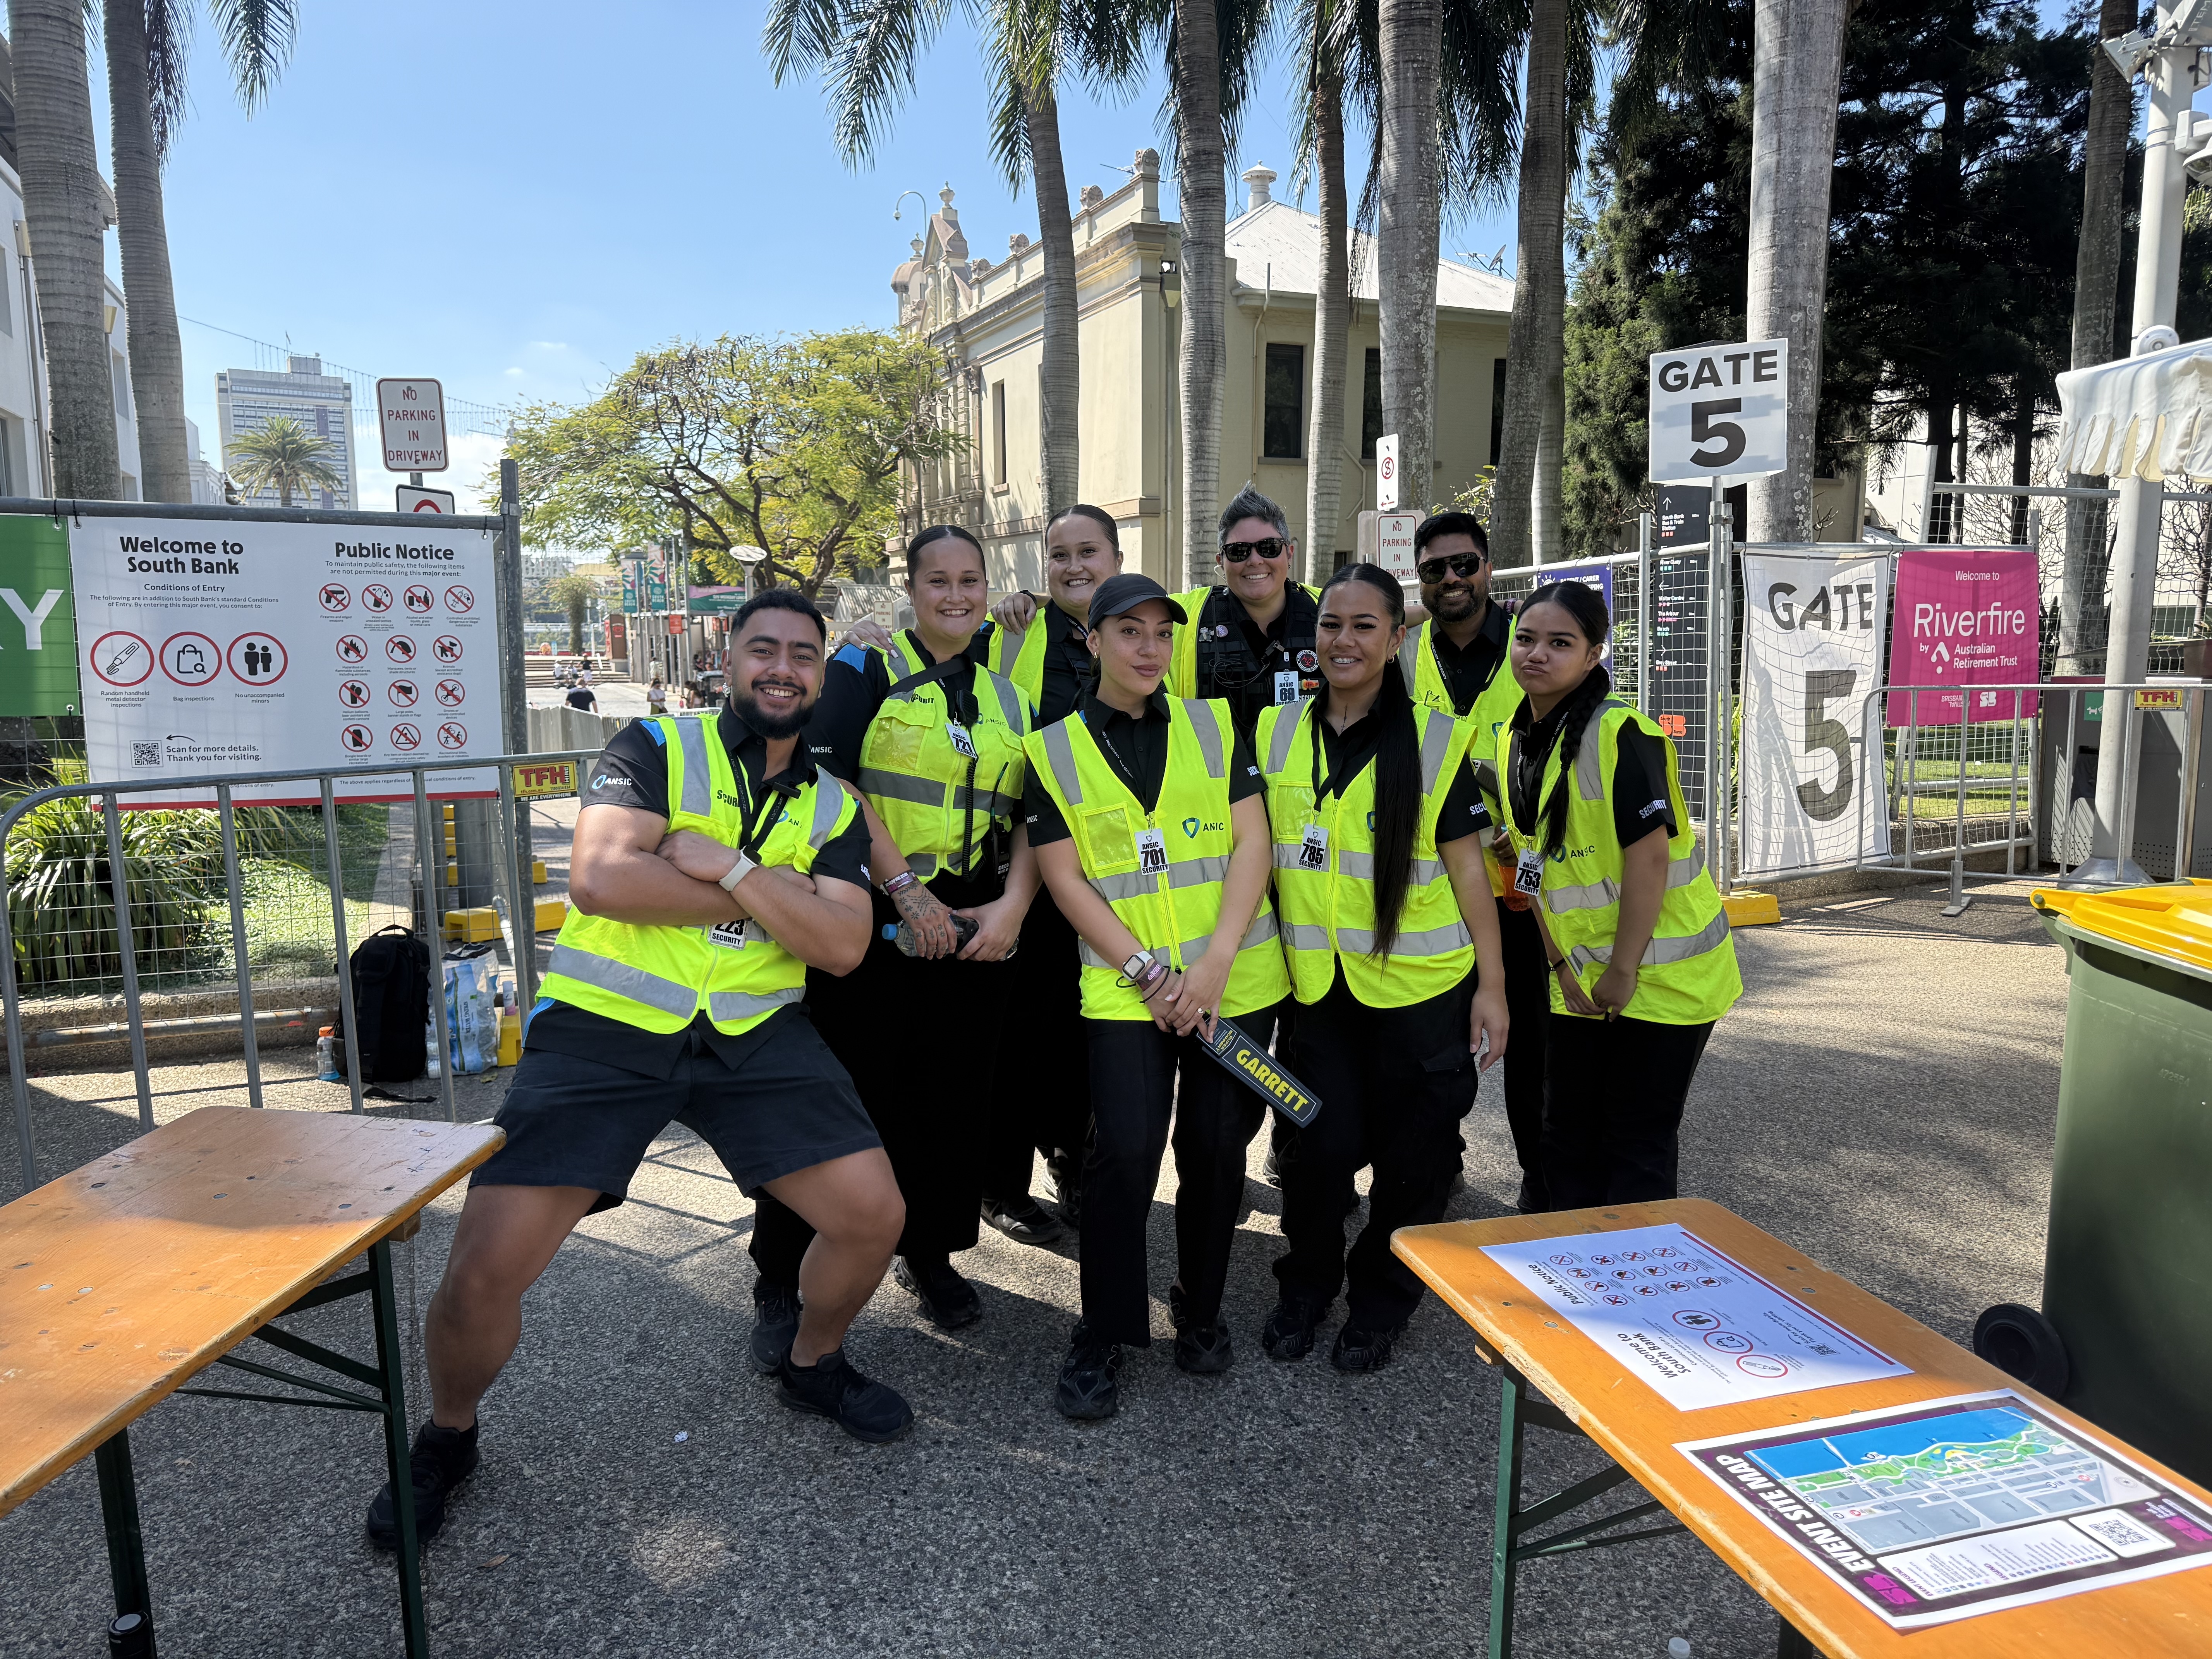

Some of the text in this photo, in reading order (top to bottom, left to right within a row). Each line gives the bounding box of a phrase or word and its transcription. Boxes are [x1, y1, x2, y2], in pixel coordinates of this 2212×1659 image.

[1658, 349, 1778, 392] GATE
[403, 389, 417, 400] NO
[388, 410, 435, 421] PARKING
[409, 430, 419, 441] IN
[1689, 397, 1746, 467] 5
[388, 450, 442, 462] DRIVEWAY
[1393, 523, 1402, 531] NO
[120, 536, 243, 555] Welcome to
[1382, 538, 1412, 547] PARKING
[335, 543, 454, 560] Public Notice
[1393, 554, 1401, 562] IN
[128, 557, 239, 574] South Bank
[1955, 570, 2000, 581] Welcome to
[1768, 582, 1872, 631] GATE
[1913, 602, 2025, 637] Riverfire
[1920, 643, 1996, 655] by Australian
[1953, 655, 2018, 669] Retirement Trust
[2140, 691, 2174, 702] TFH
[986, 718, 1006, 726] ANSIC
[953, 732, 966, 740] ANSIC
[952, 736, 973, 752] 721
[1796, 670, 1857, 822] 5
[955, 746, 976, 758] SECURITY
[519, 766, 565, 787] TFH
[605, 778, 632, 786] ANSIC
[1639, 799, 1666, 819] SECURITY
[1307, 838, 1321, 846] ANSIC
[1140, 848, 1166, 868] 701
[1301, 843, 1324, 864] 785
[1570, 845, 1595, 858] ANSIC
[1142, 864, 1168, 874] SECURITY
[1299, 859, 1321, 871] SECURITY
[1522, 862, 1538, 871] ANSIC
[1518, 870, 1541, 888] 753
[1515, 883, 1539, 895] SECURITY
[712, 933, 741, 945] SECURITY
[1218, 1030, 1233, 1049] SCANNER
[1221, 1036, 1233, 1050] SUPER
[1237, 1049, 1308, 1112] GARRETT
[1528, 1264, 1583, 1305] Public Notice
[1617, 1333, 1678, 1378] Welcome to
[1632, 1333, 1691, 1374] South Bank
[1716, 1455, 1875, 1571] EVENT SITE MAP
[1982, 1563, 2010, 1580] LEGEND
[1891, 1566, 1934, 1596] EVENT LEGEND
